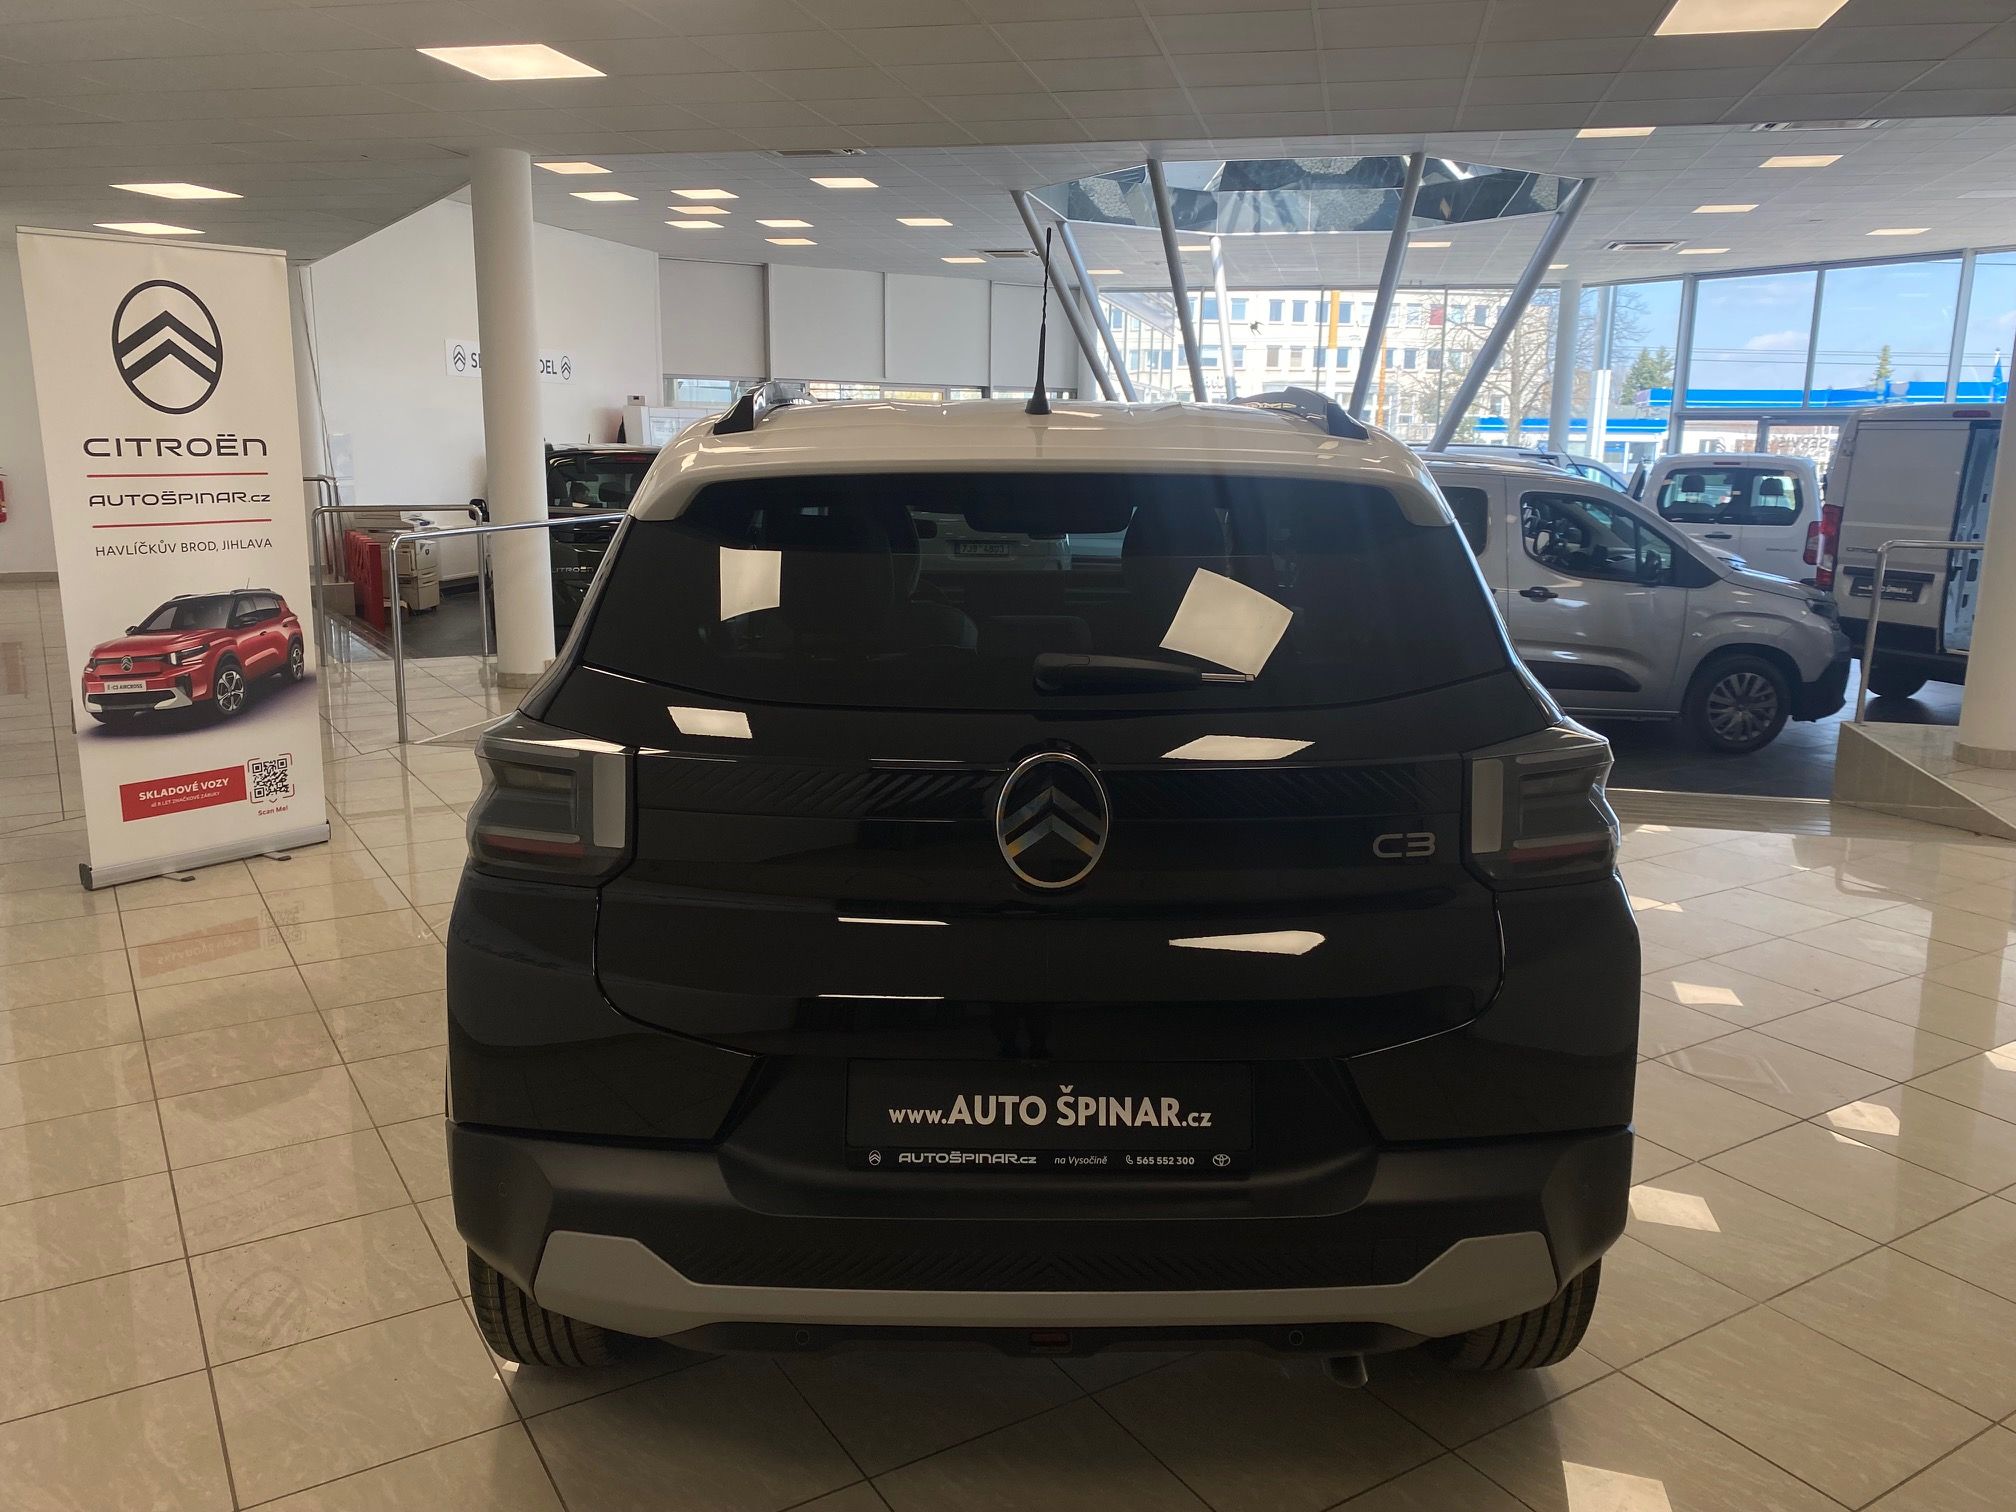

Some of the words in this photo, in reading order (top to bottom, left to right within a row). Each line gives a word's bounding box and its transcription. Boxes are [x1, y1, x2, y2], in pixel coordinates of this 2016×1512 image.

[471, 352, 481, 369] S
[83, 434, 267, 457] CITROËN
[89, 491, 271, 507] AUTOŠPINAR.cz
[96, 539, 177, 557] HAVLÍČKŮV
[181, 540, 219, 553] BROD,
[222, 538, 273, 551] JIHLAVA
[139, 781, 199, 801] SKLADOVÉ
[201, 778, 230, 790] VOZY
[257, 807, 275, 816] Scan
[276, 805, 289, 813] Me!
[1373, 832, 1435, 858] C3
[888, 1094, 1047, 1126] www.AUTO
[1056, 1085, 1212, 1127] ŠPINAR.cz
[898, 1151, 1037, 1164] AUTOŠPINAR.cz
[1054, 1157, 1066, 1165] na
[1068, 1155, 1108, 1166] Vysočině
[1136, 1157, 1156, 1165] 565
[1156, 1157, 1175, 1165] 552
[1176, 1157, 1195, 1165] 300
